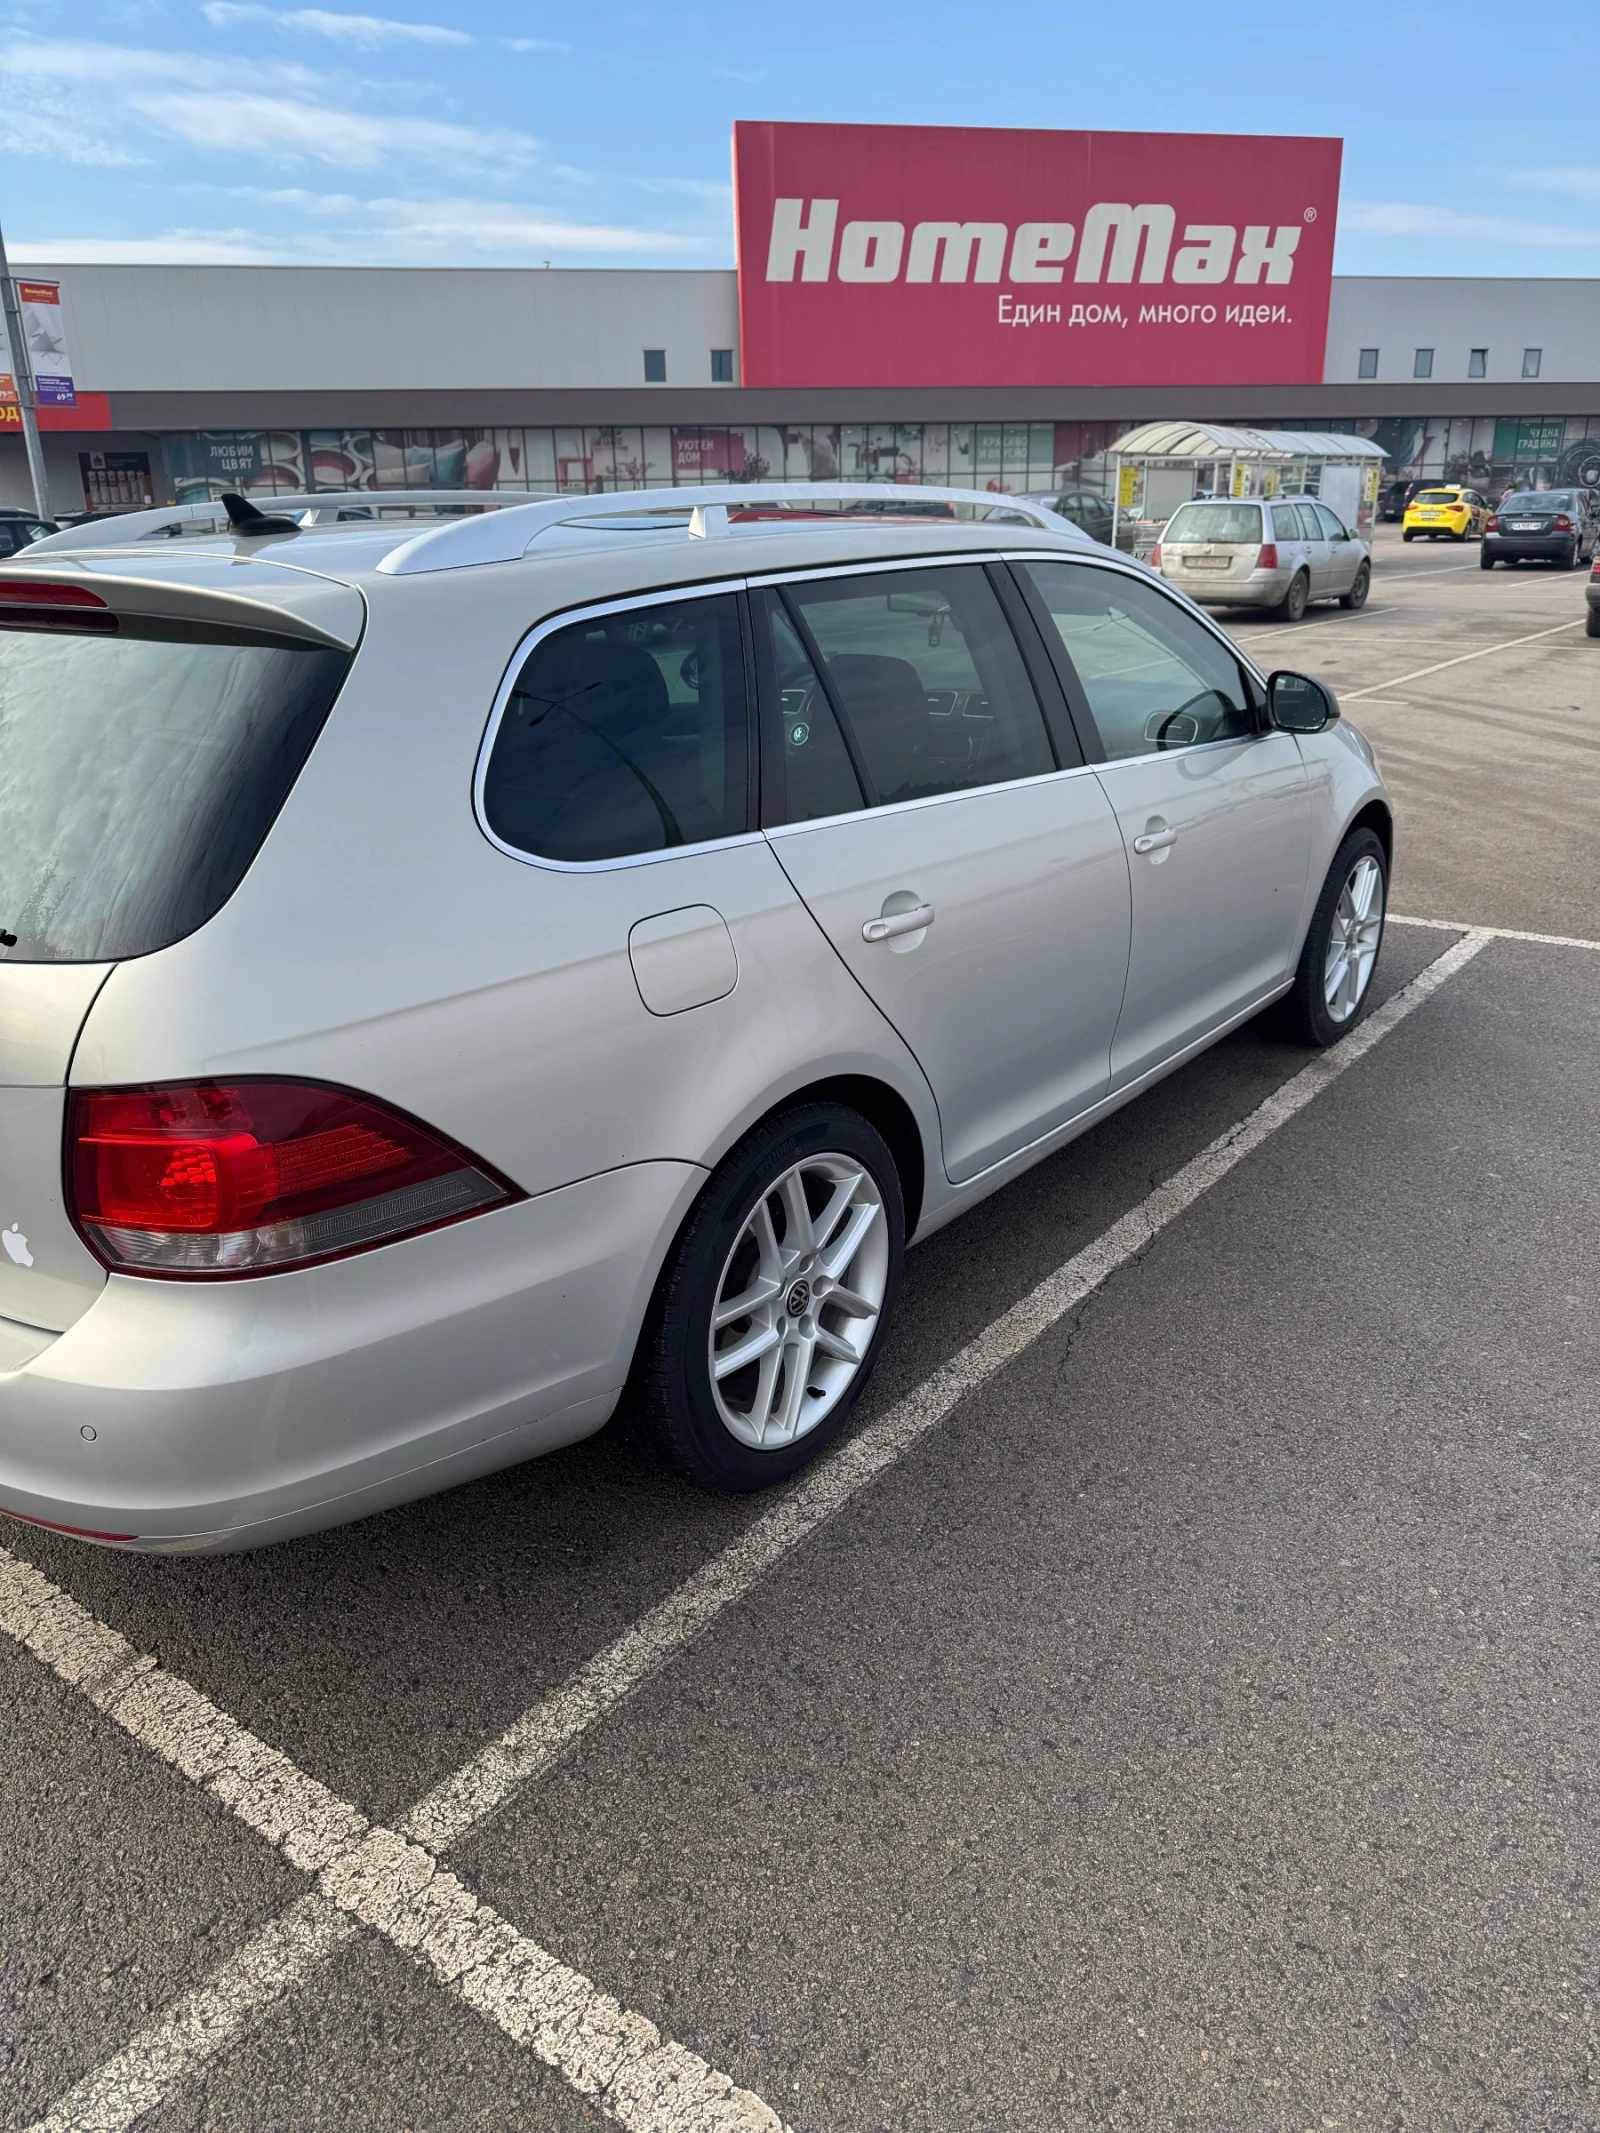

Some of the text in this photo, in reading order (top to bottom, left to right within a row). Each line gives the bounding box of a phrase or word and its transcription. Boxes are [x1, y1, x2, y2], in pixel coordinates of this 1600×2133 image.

[765, 198, 1303, 285] HomeMax
[998, 295, 1293, 328] Един дом, много идеи.
[1530, 427, 1559, 438] ЧУДНА
[677, 440, 714, 451] УЮТЕН
[1517, 439, 1557, 449] ГРАДИНА
[210, 445, 254, 457] ЛЮБИМ
[221, 458, 253, 471] ЦВЯТ
[678, 452, 701, 465] ДОМ
